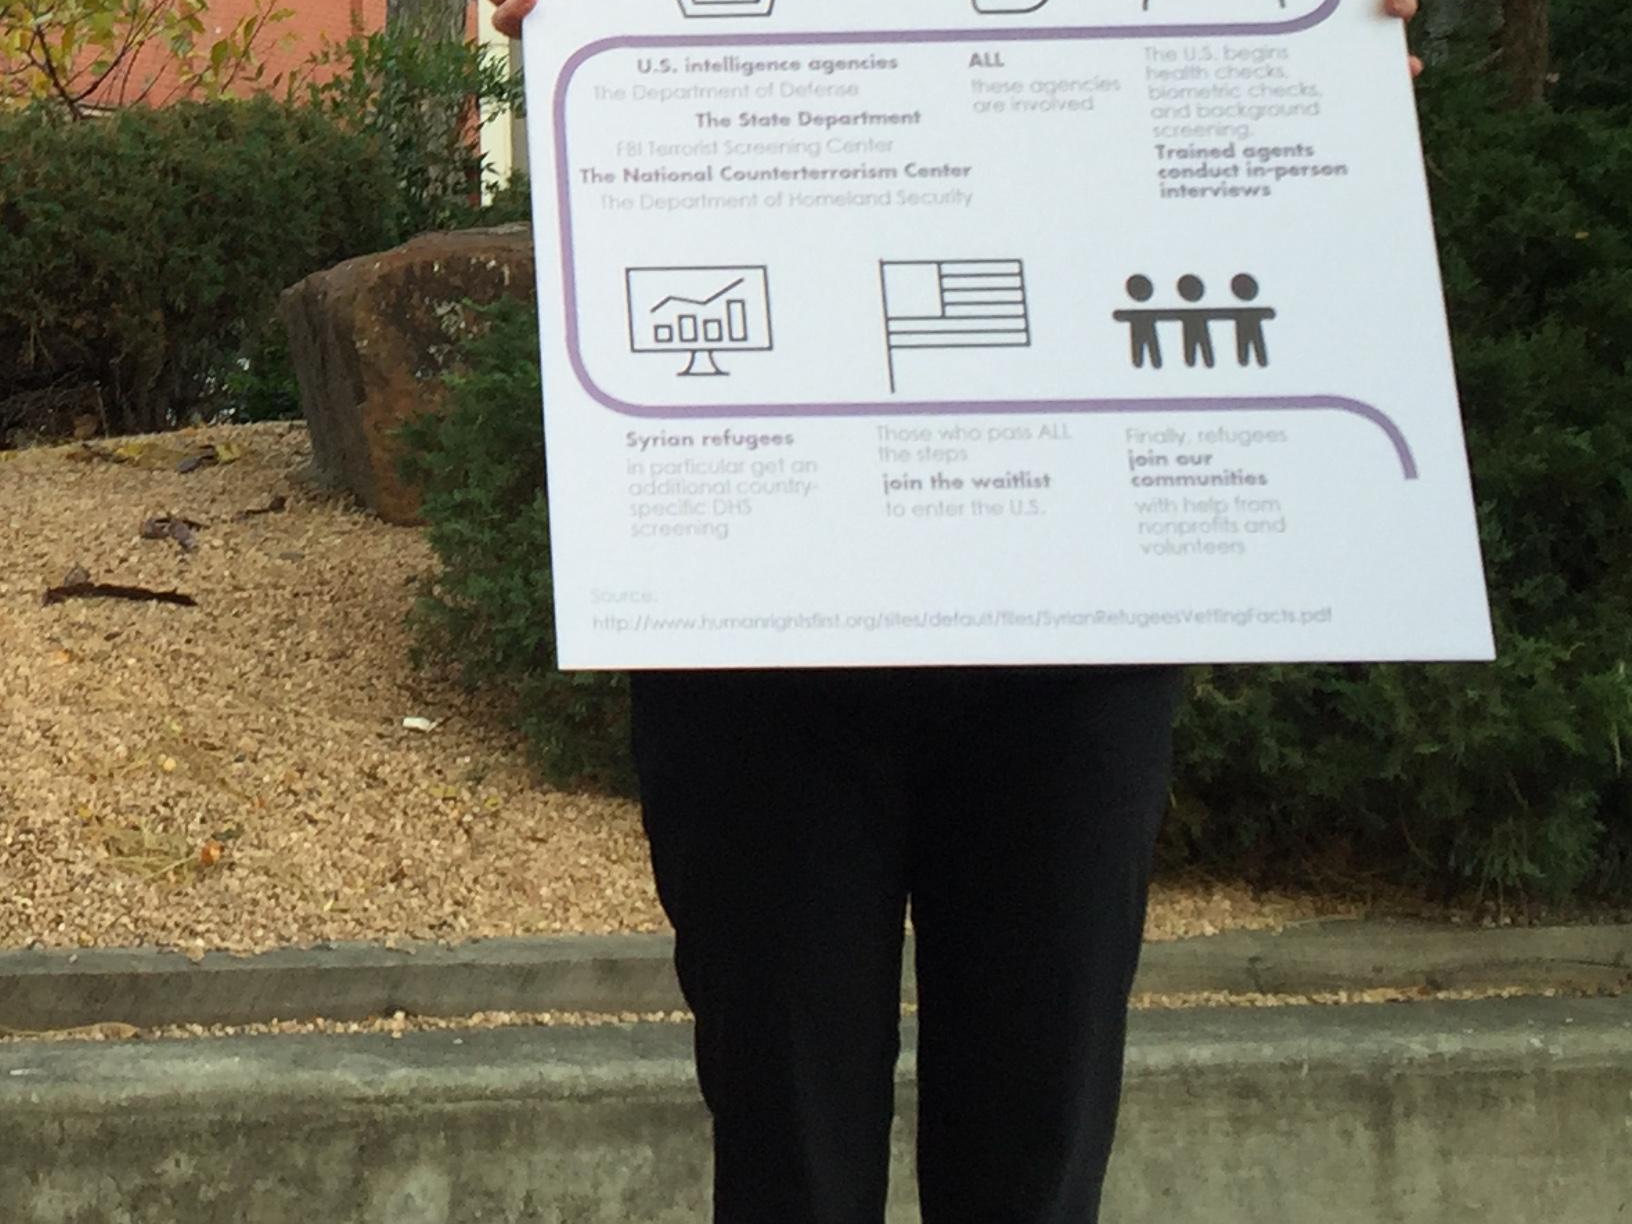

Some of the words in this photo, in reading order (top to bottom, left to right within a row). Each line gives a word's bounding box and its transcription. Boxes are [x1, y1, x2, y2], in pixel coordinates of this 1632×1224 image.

[969, 53, 1004, 68] ALL
[1144, 47, 1176, 62] The
[1183, 46, 1217, 60] U.S.
[1224, 45, 1288, 64] begins
[637, 58, 677, 73] U.S.
[685, 57, 800, 75] intelligence
[808, 55, 898, 73] agencies
[1146, 65, 1206, 80] health
[594, 85, 627, 100] The
[633, 83, 747, 103] Department
[756, 83, 774, 98] of
[780, 81, 859, 96] Defense
[971, 78, 1024, 94] these
[1030, 77, 1121, 96] agencies
[1148, 84, 1240, 99] biometric
[973, 98, 1006, 113] are
[1011, 96, 1094, 112] involved
[1150, 103, 1190, 118] and
[1196, 102, 1320, 120] background
[696, 113, 732, 128] The
[739, 112, 790, 127] State
[798, 110, 921, 129] Department
[617, 141, 642, 156] FBI
[649, 140, 717, 156] Terrorist
[724, 138, 820, 158] Screening
[826, 136, 893, 153] Center
[1156, 145, 1235, 160] Trained
[1242, 144, 1313, 163] agents
[580, 168, 616, 184] The
[623, 166, 712, 182] National
[720, 164, 897, 181] Counterterrorism
[905, 163, 972, 178] Center
[1158, 163, 1238, 178] conduct
[1247, 162, 1347, 180] in-person
[1160, 182, 1271, 198] interviews
[600, 193, 634, 210] The
[640, 192, 757, 211] Department
[766, 192, 784, 207] of
[789, 190, 891, 207] Homeland
[896, 189, 972, 207] Security
[626, 431, 694, 451] Syrian
[702, 430, 794, 450] refugees
[876, 425, 931, 442] Those
[937, 425, 982, 441] who
[988, 425, 1033, 445] pass
[1039, 423, 1071, 440] ALL
[1198, 426, 1287, 446] refugees
[878, 446, 911, 462] the
[917, 446, 967, 466] steps
[1129, 451, 1168, 471] join
[1176, 453, 1212, 466] our
[626, 458, 644, 473] in
[650, 458, 745, 477] particular
[751, 458, 785, 476] get
[791, 459, 817, 473] an
[628, 478, 730, 496] additional
[883, 474, 922, 494] join
[930, 473, 964, 490] the
[971, 473, 1050, 490] waitlist
[1132, 470, 1266, 487] communities
[630, 499, 706, 520] specific
[713, 499, 752, 515] DHS
[886, 501, 905, 517] to
[913, 499, 965, 516] enter
[971, 499, 1003, 516] the
[1010, 498, 1046, 515] U.S.
[1136, 498, 1176, 514] with
[1183, 496, 1228, 518] help
[1234, 496, 1281, 513] from
[631, 520, 729, 539] screening
[1138, 517, 1236, 537] nonprofits
[1243, 517, 1286, 533] and
[1140, 539, 1245, 555] volunteers
